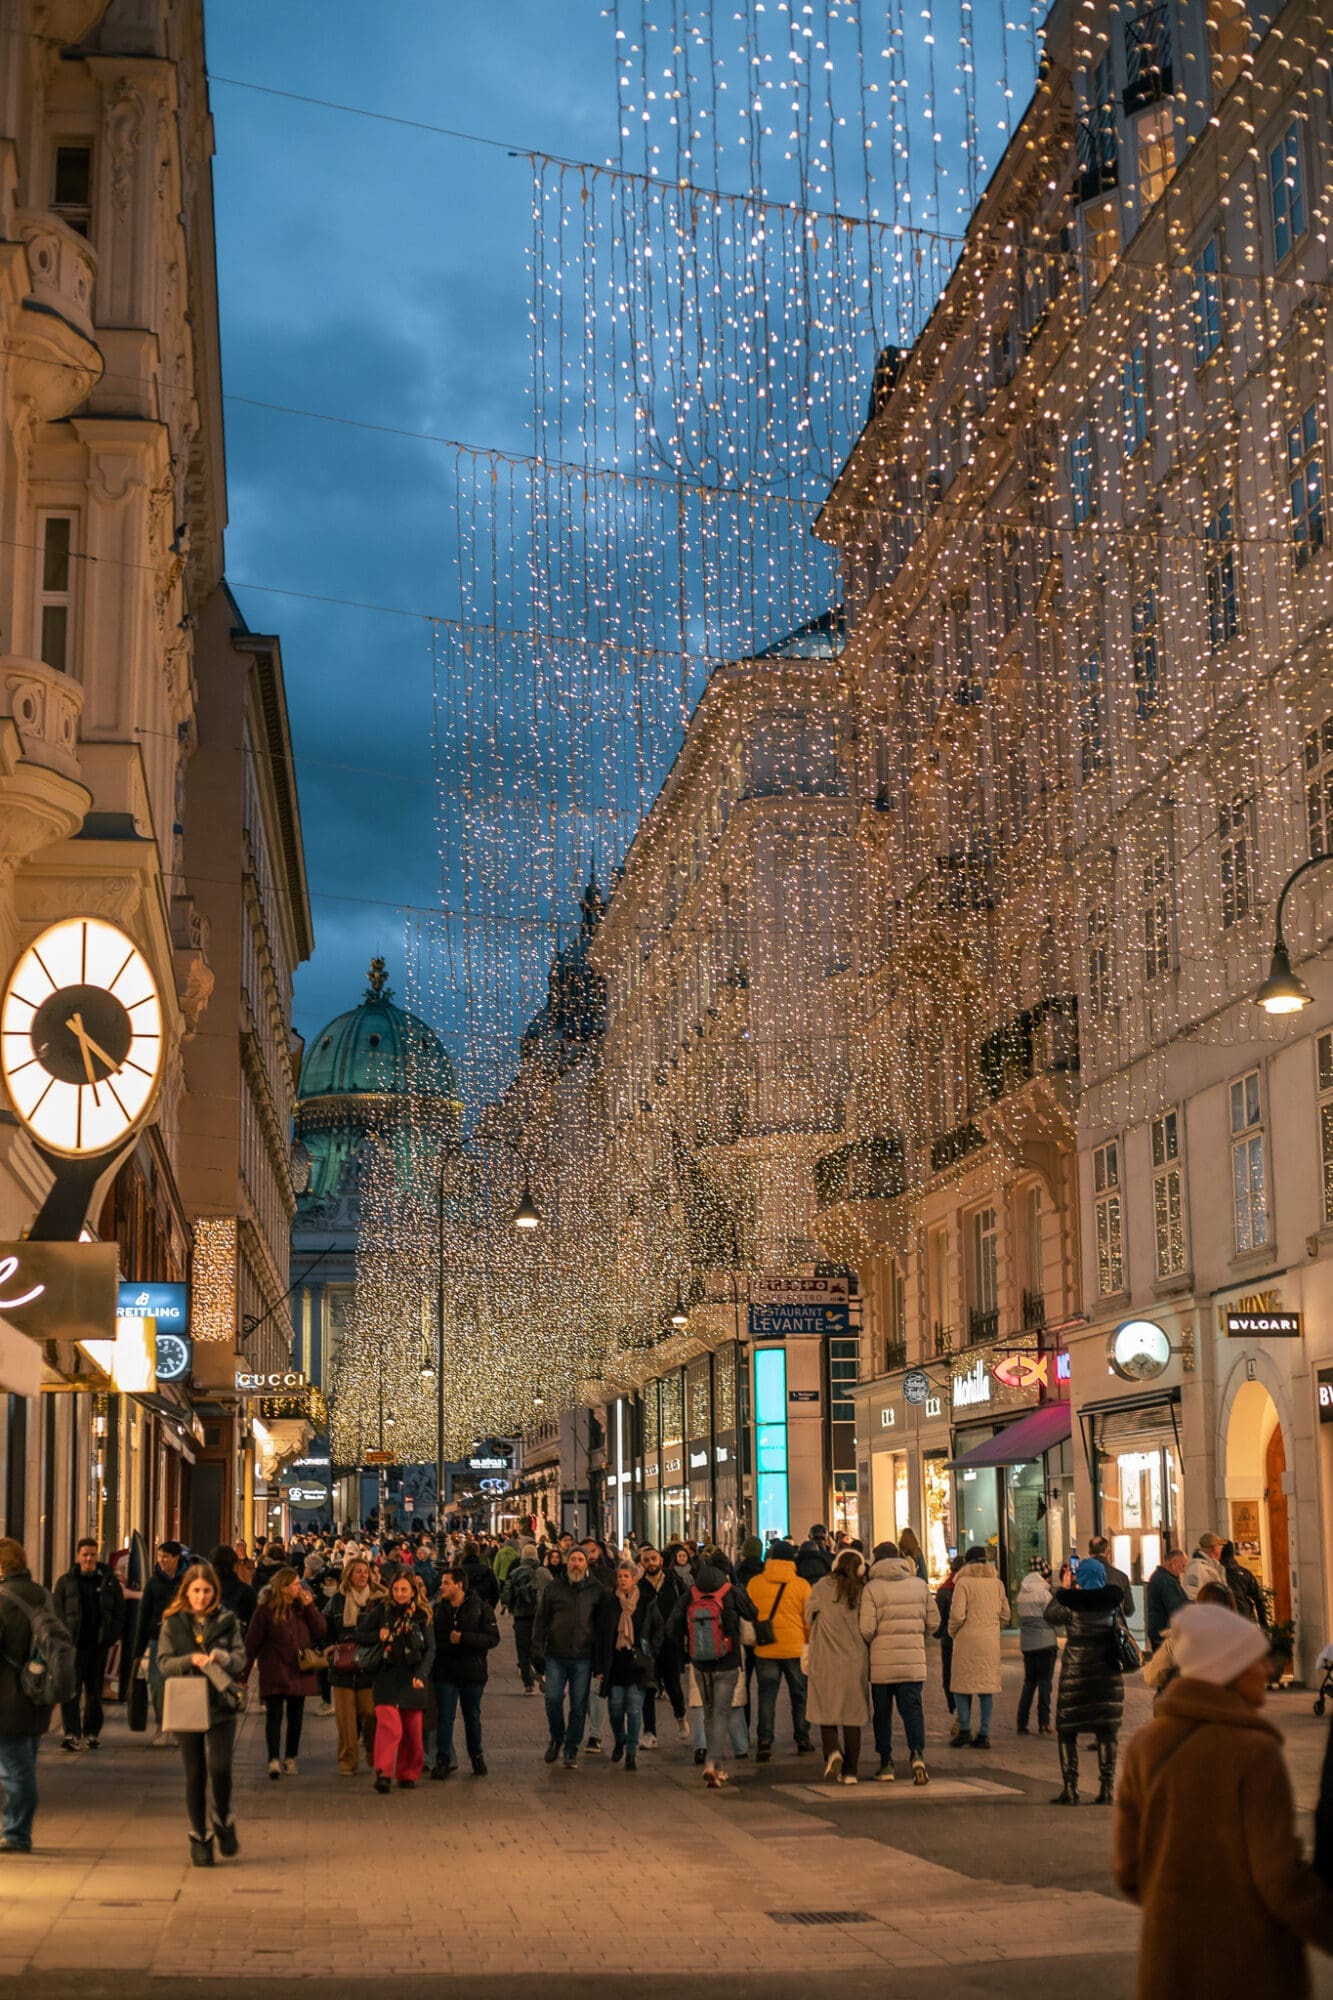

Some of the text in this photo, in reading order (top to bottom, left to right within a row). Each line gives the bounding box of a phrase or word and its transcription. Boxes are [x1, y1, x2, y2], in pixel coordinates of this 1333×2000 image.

[116, 1307, 179, 1317] REITLING
[753, 1307, 824, 1316] RESTAURANT
[753, 1318, 824, 1331] LEVANTE
[1229, 1320, 1298, 1330] BVLGARI
[239, 1373, 304, 1386] GUCCI
